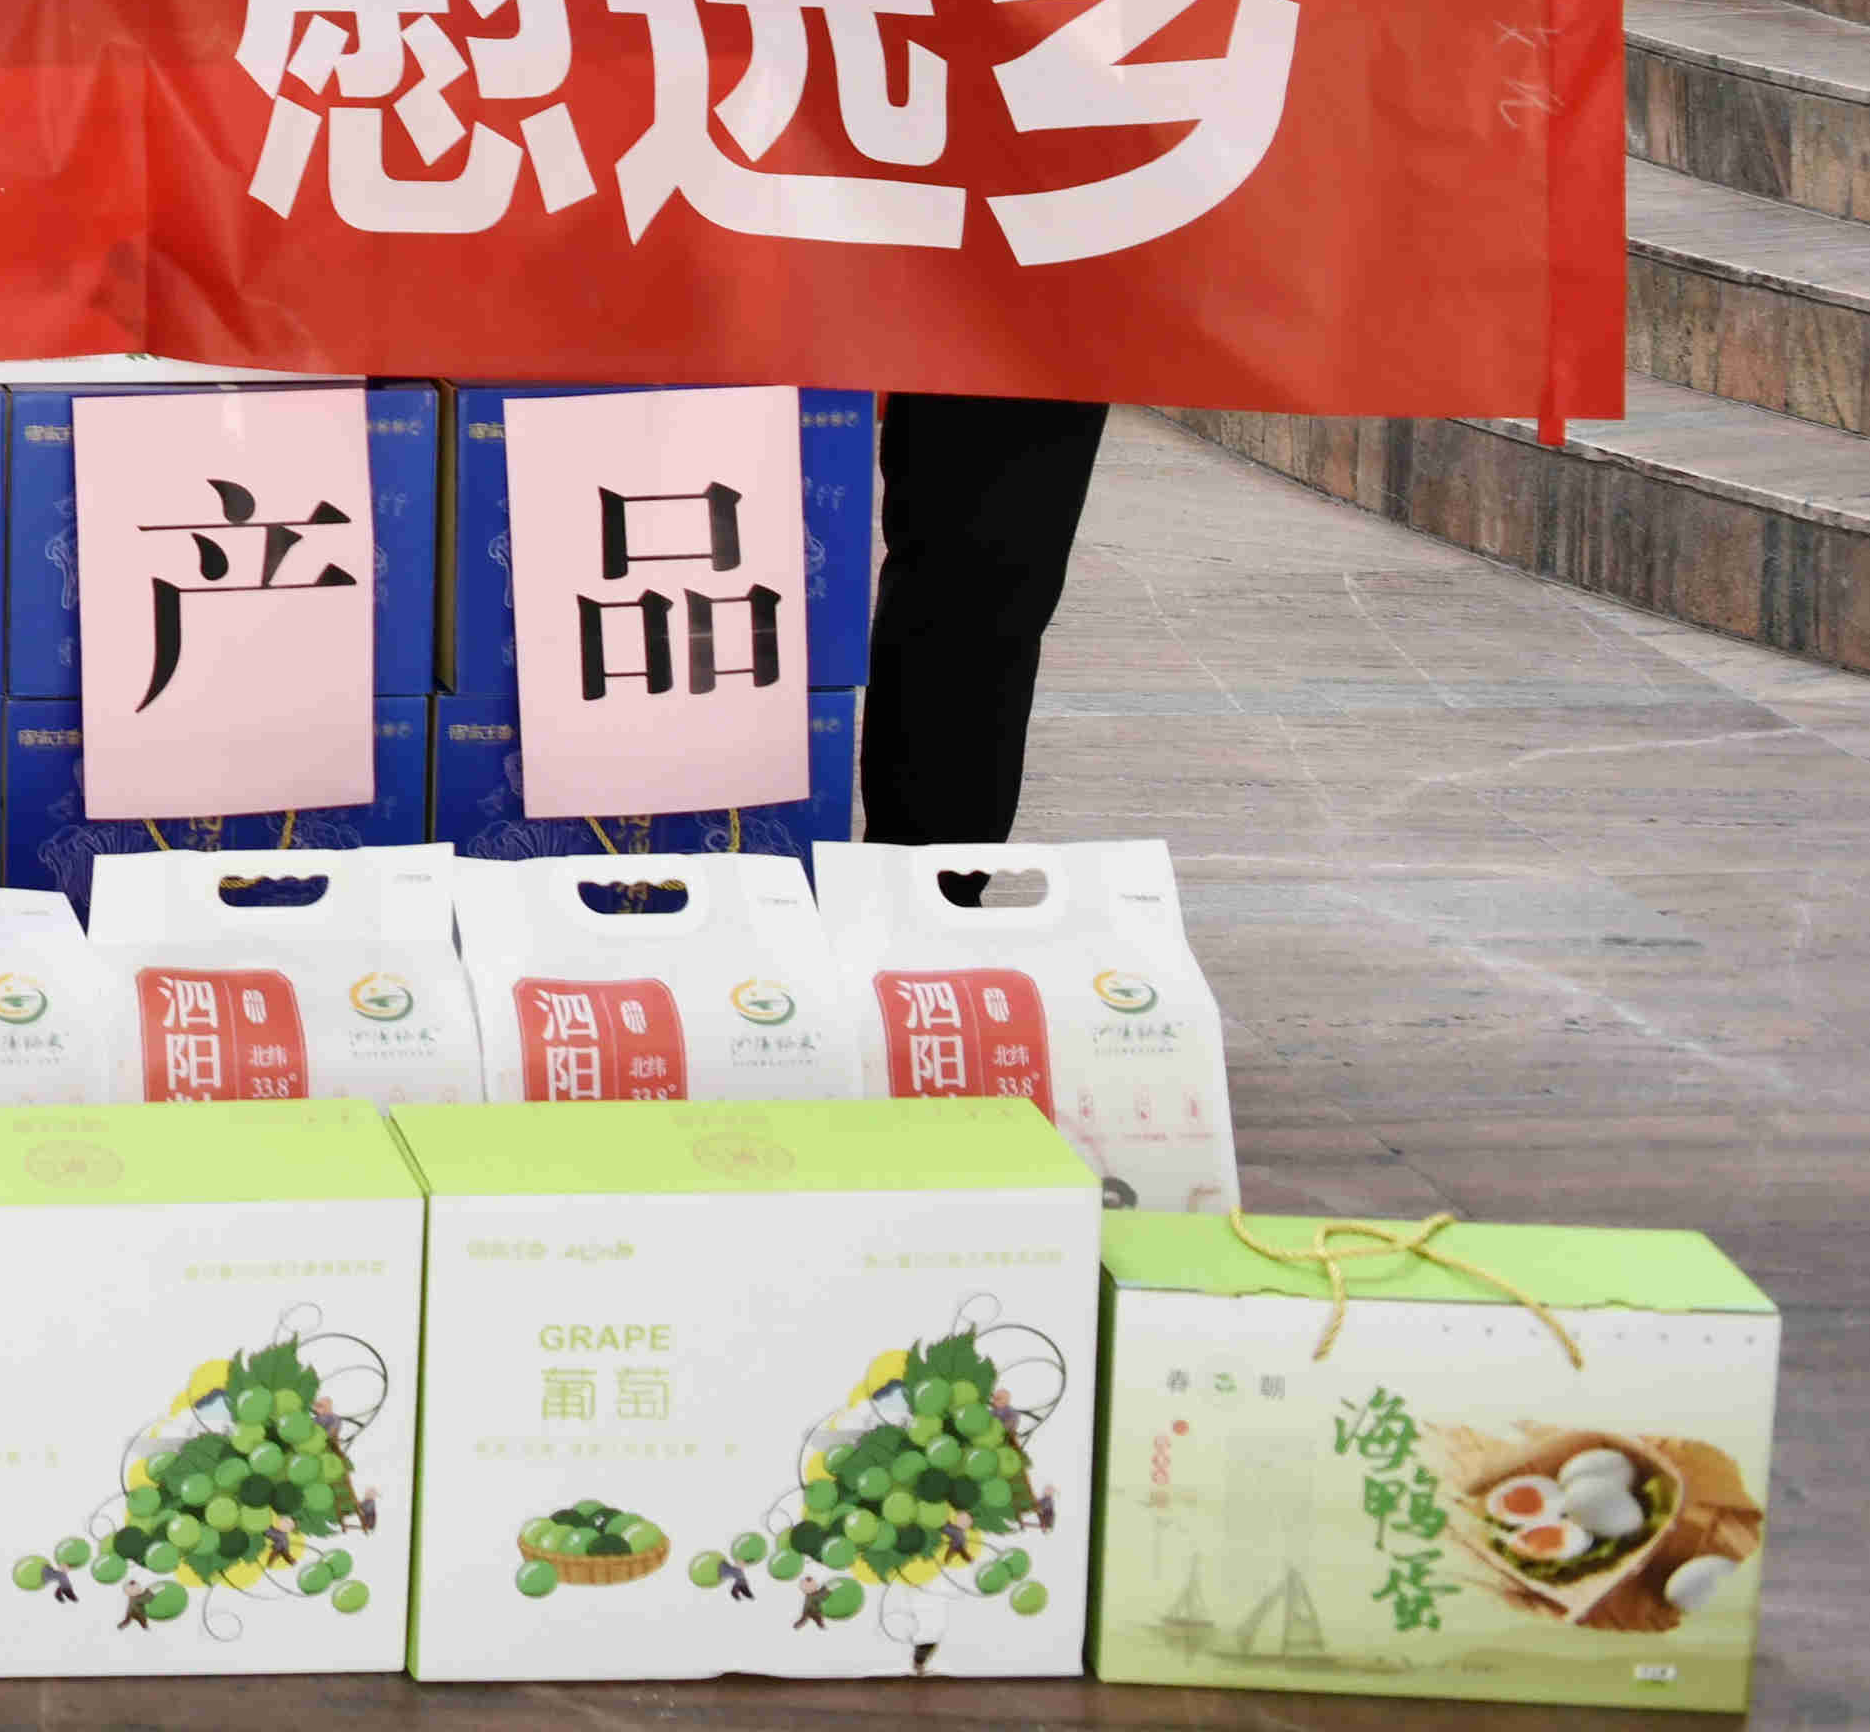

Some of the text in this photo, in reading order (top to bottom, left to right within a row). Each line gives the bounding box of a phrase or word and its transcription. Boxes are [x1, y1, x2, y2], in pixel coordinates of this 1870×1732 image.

[158, 975, 222, 1098] 泗阳
[251, 1072, 298, 1098] 33.8°
[534, 988, 603, 1101] 泗阳
[895, 979, 967, 1095] 泗阳
[539, 1324, 672, 1352] GRAPE
[541, 1367, 672, 1421] 葡萄
[1333, 1386, 1461, 1632] 海鸭蛋
